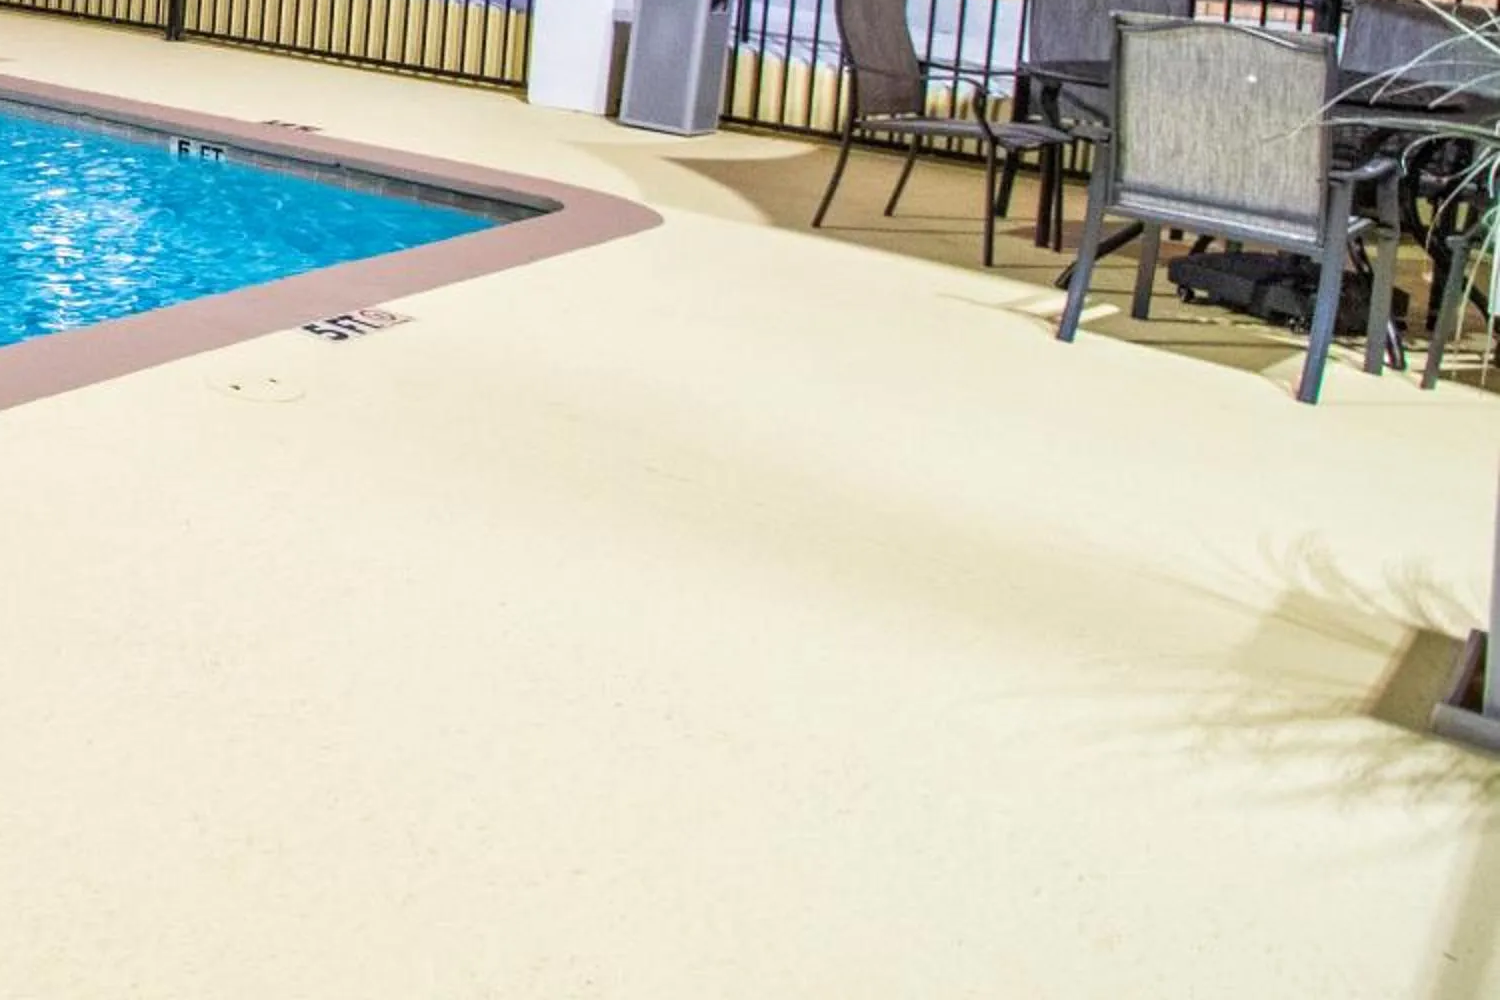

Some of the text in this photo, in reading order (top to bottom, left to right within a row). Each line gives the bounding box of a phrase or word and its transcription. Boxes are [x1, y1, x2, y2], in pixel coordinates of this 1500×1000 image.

[201, 144, 224, 160] FT
[302, 314, 381, 341] 5 FT
